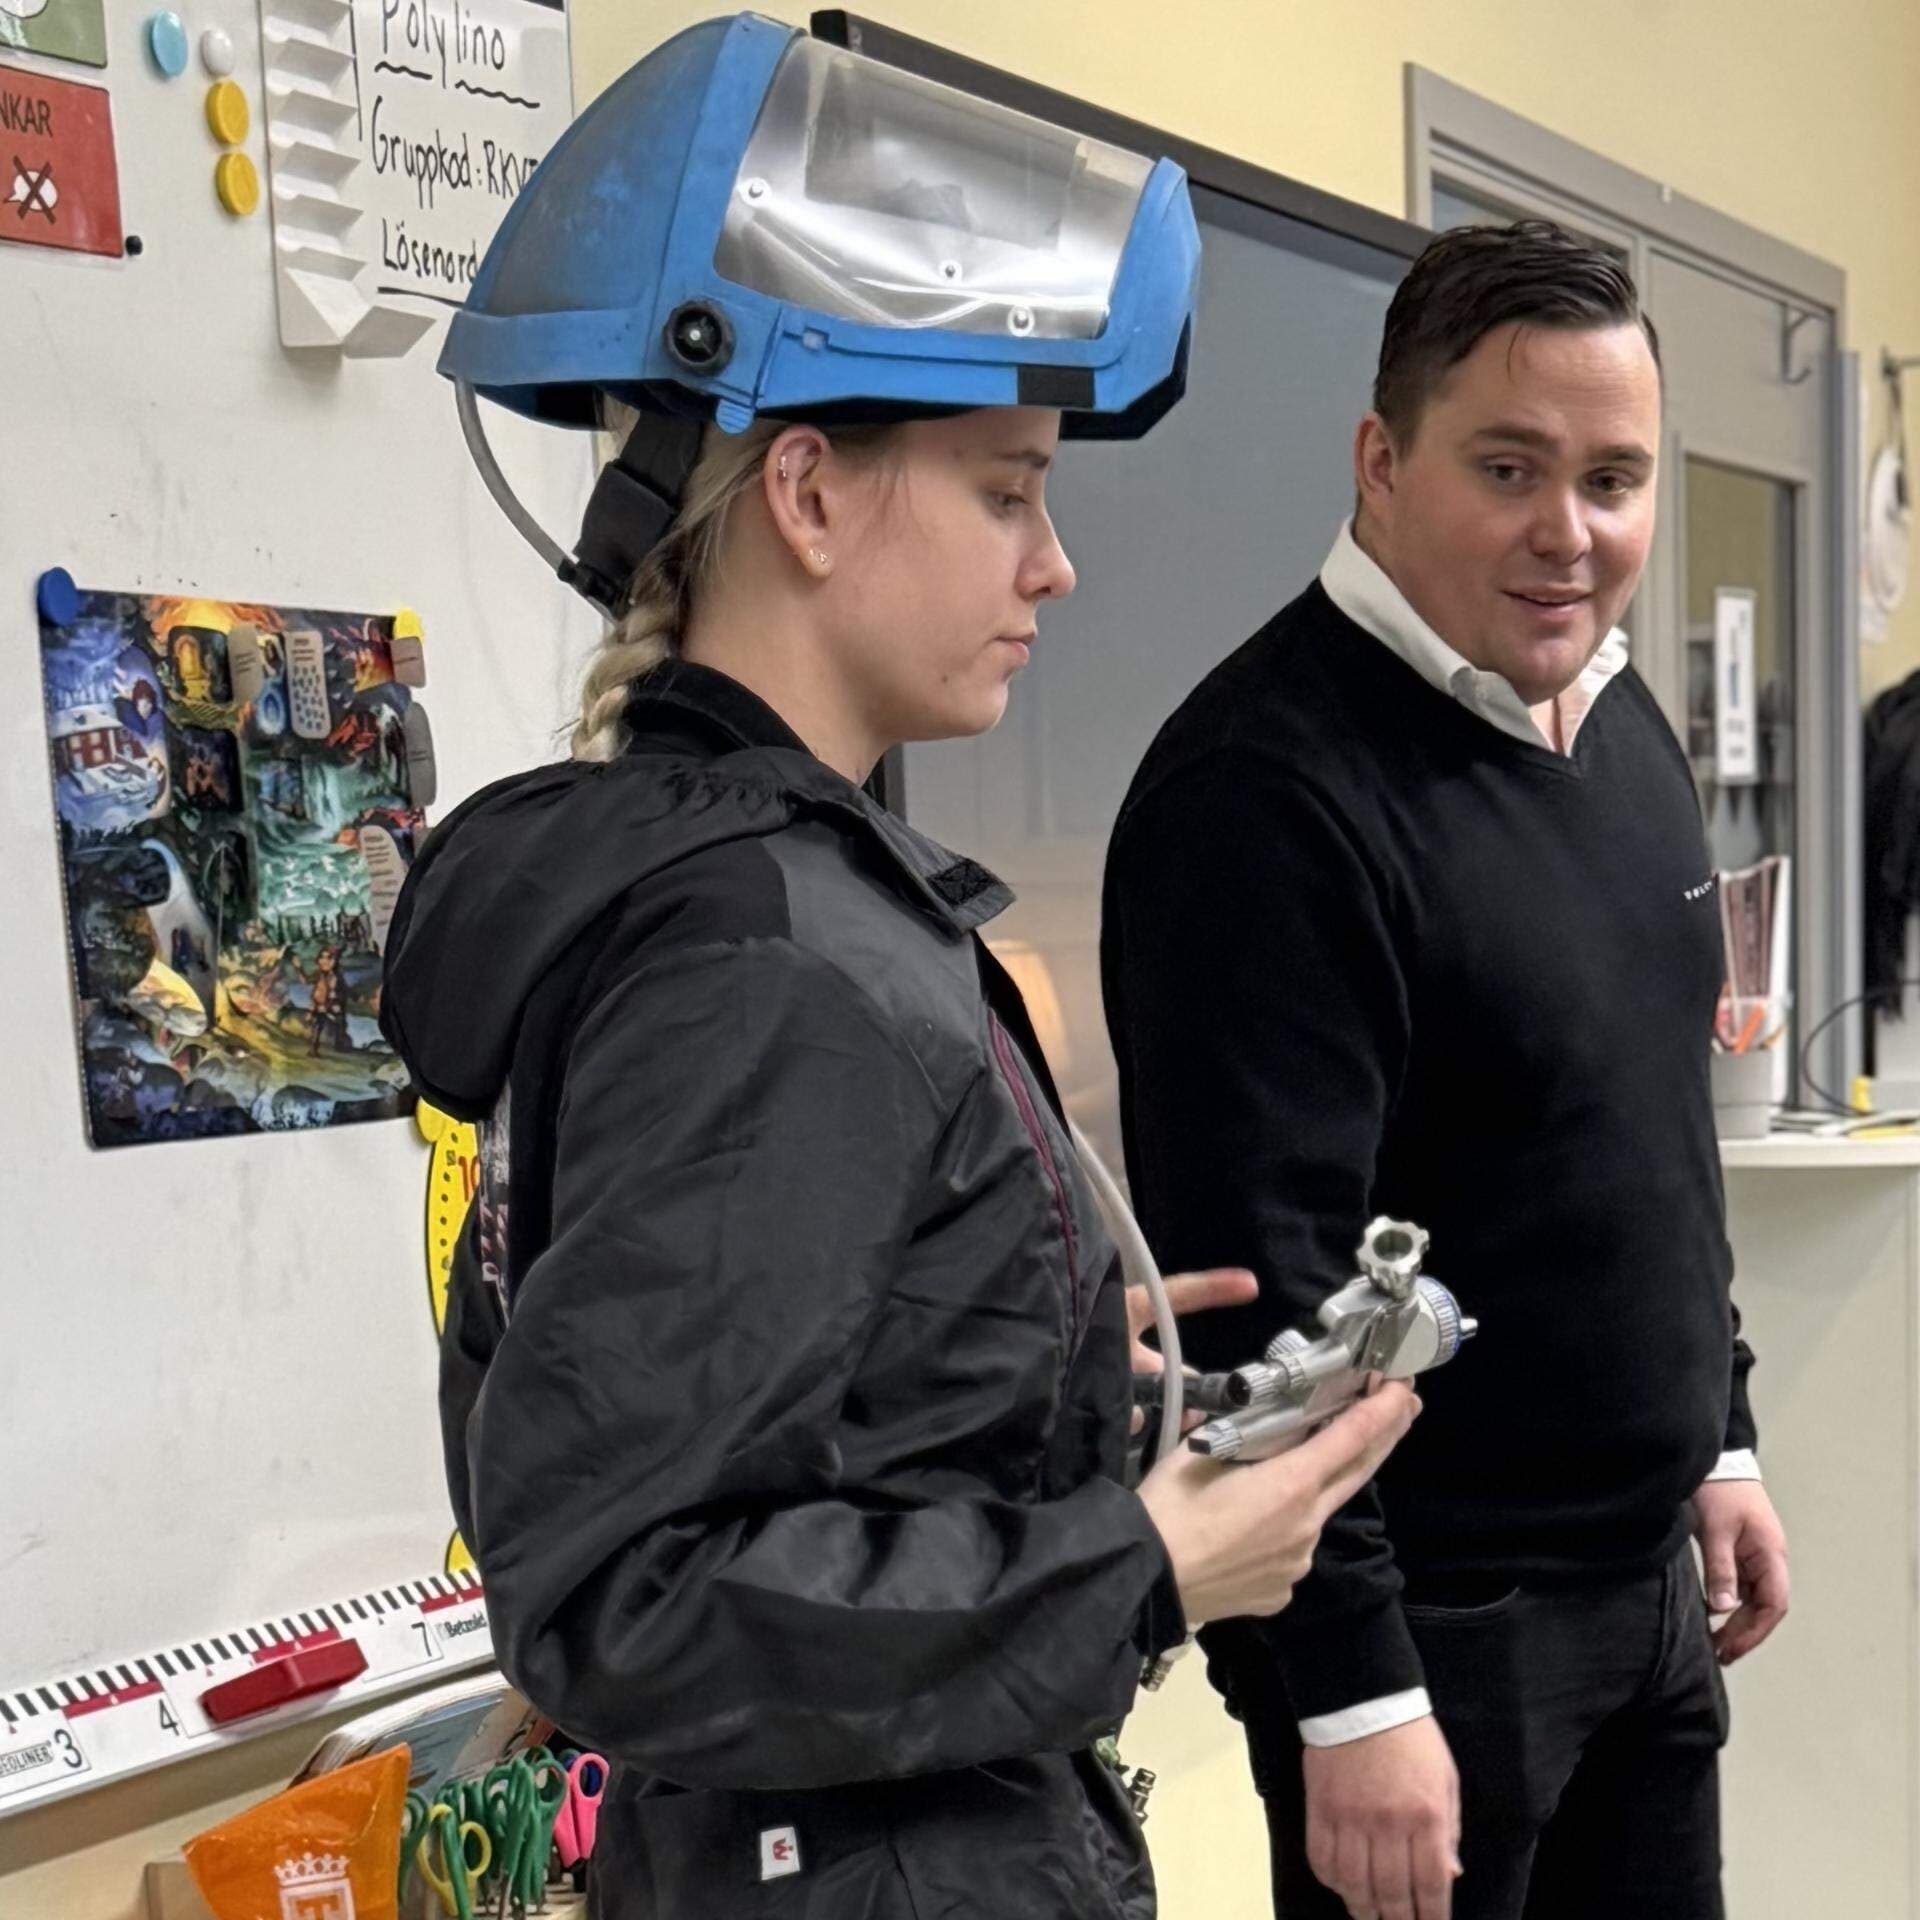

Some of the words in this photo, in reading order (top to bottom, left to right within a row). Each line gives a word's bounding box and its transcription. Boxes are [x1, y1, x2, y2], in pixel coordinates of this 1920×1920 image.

[382, 217, 478, 283] Lösenord
[411, 1621, 432, 1657] 7
[159, 1698, 180, 1736] 4
[54, 1728, 83, 1769] 3
